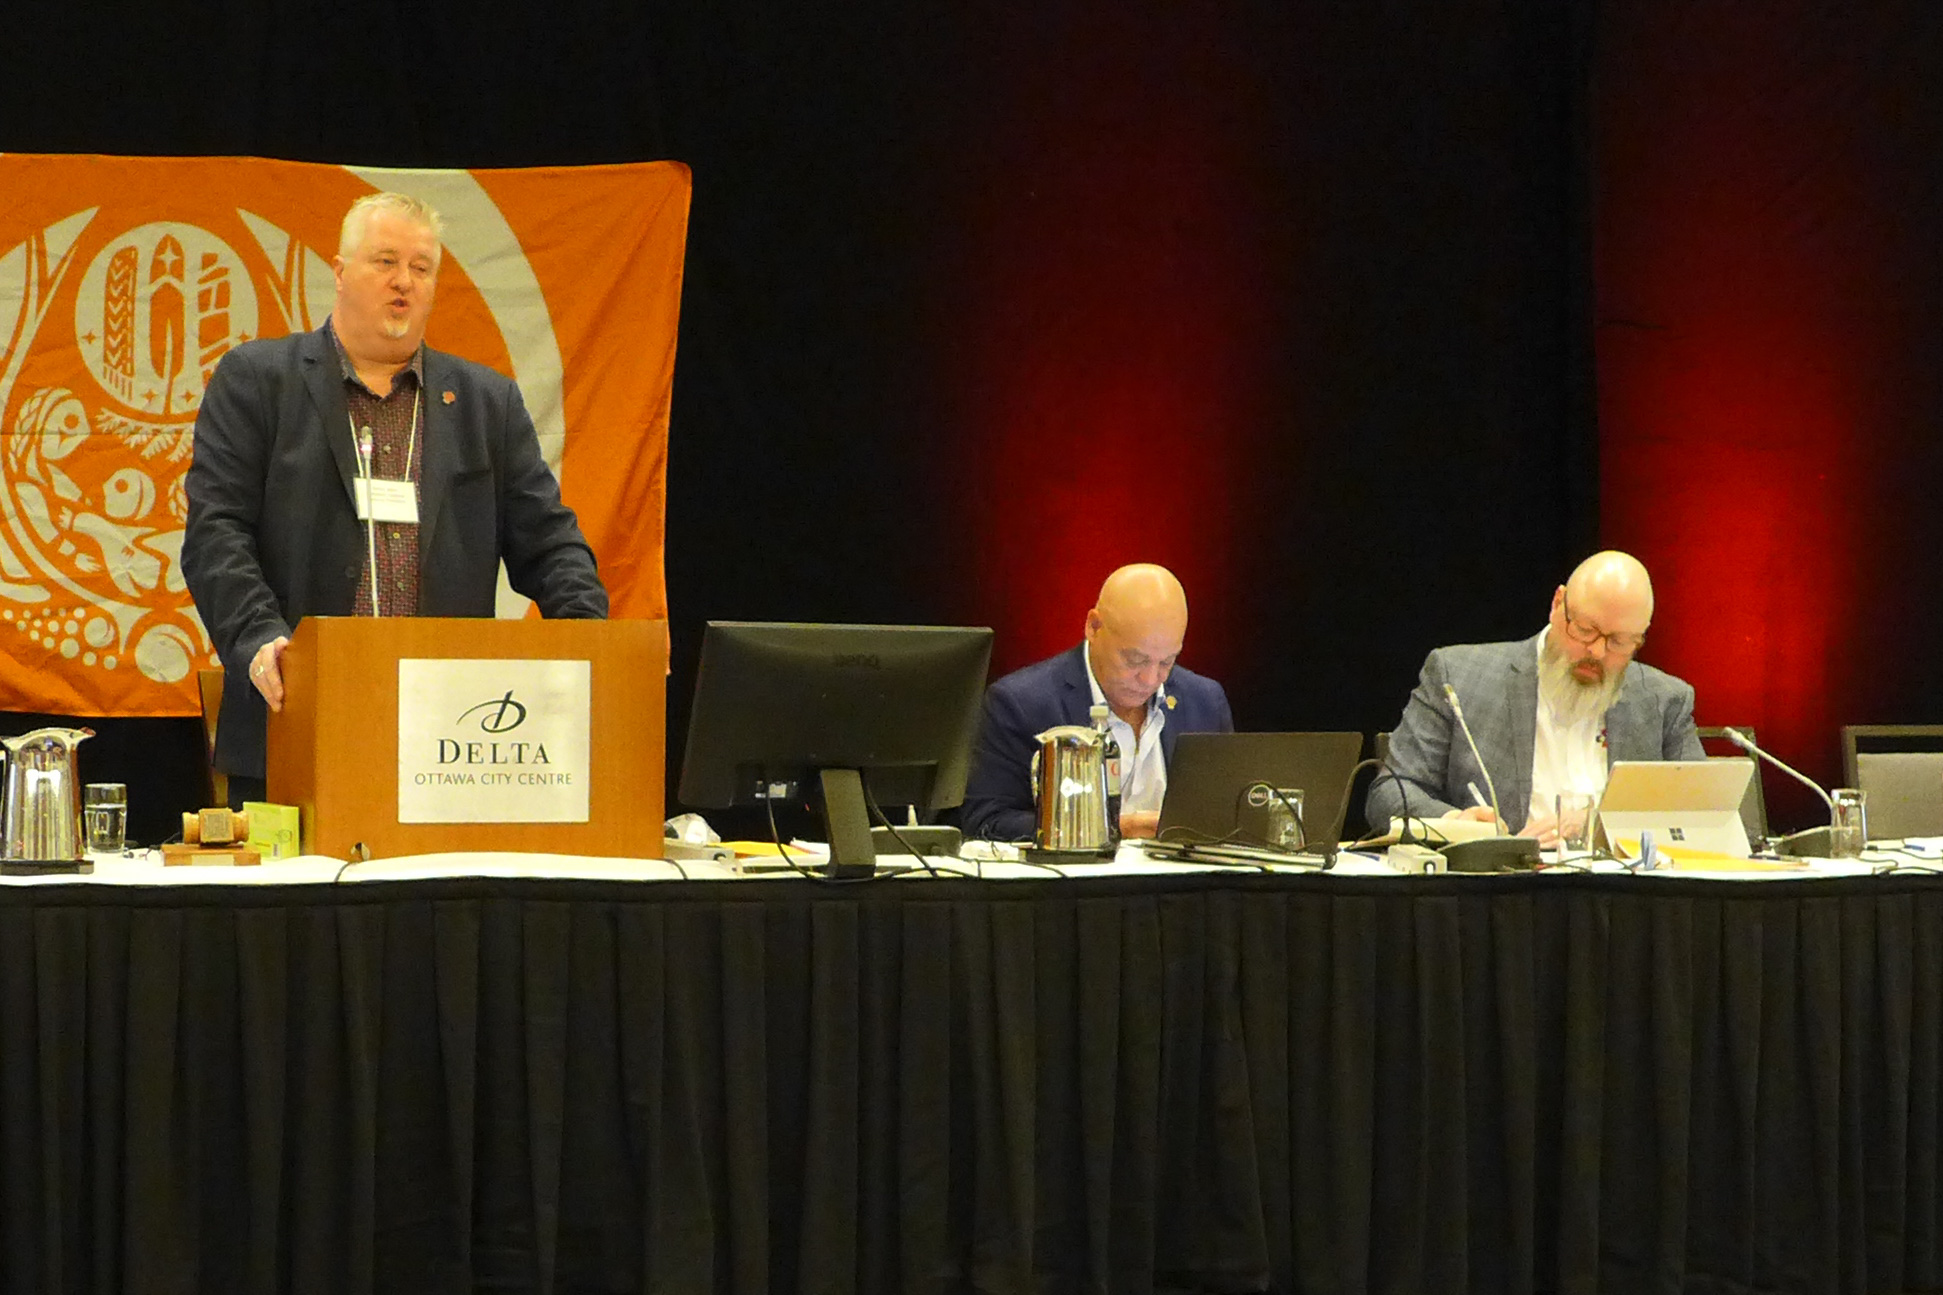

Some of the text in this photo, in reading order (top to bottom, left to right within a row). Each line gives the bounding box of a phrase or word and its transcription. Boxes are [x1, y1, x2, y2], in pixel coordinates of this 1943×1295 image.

[437, 738, 551, 764] DELTA
[415, 773, 572, 785] OTTAWA CITY CENTRE
